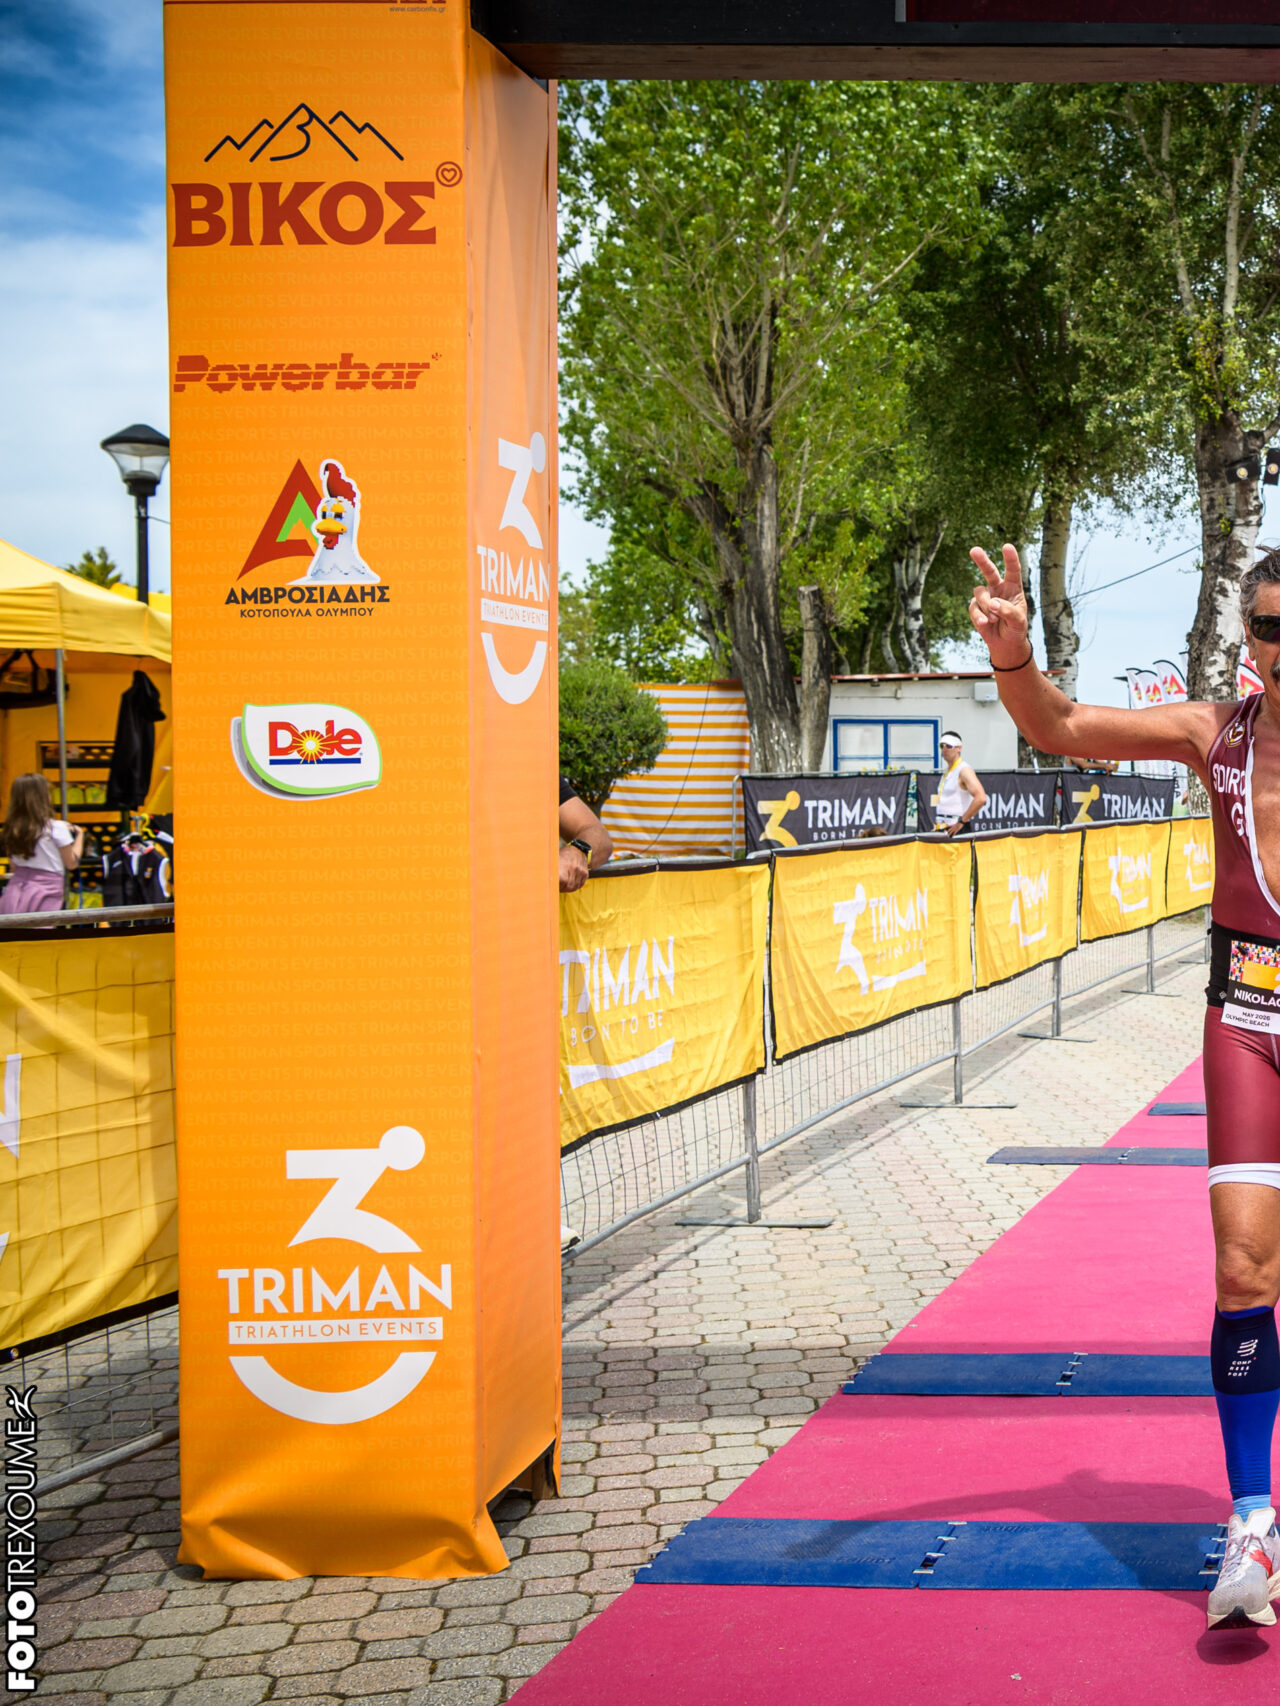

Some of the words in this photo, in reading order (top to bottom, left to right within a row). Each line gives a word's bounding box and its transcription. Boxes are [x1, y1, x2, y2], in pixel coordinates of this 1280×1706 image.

[171, 181, 437, 247] ΒΙΚΟΣ
[173, 353, 431, 393] Powerbar
[476, 544, 550, 602] TRIMAN
[225, 585, 390, 605] ΑΜΒΡΟΣΙΑΔΗΣ
[240, 607, 312, 618] ΚΟΤΟΠΟΥΛΑ
[315, 607, 374, 617] ΟΛΥΜΠΟΥ
[268, 719, 362, 761] Dole
[804, 796, 896, 828] TRIMAN
[976, 793, 1044, 819] RIMAN
[1102, 793, 1164, 818] TRIMAN
[813, 830, 847, 841] BORN
[620, 1015, 639, 1037] TO
[647, 1009, 664, 1030] BE
[217, 1264, 452, 1314] TRIMAN
[235, 1324, 351, 1339] TRIATHLON
[359, 1321, 437, 1336] EVENTS
